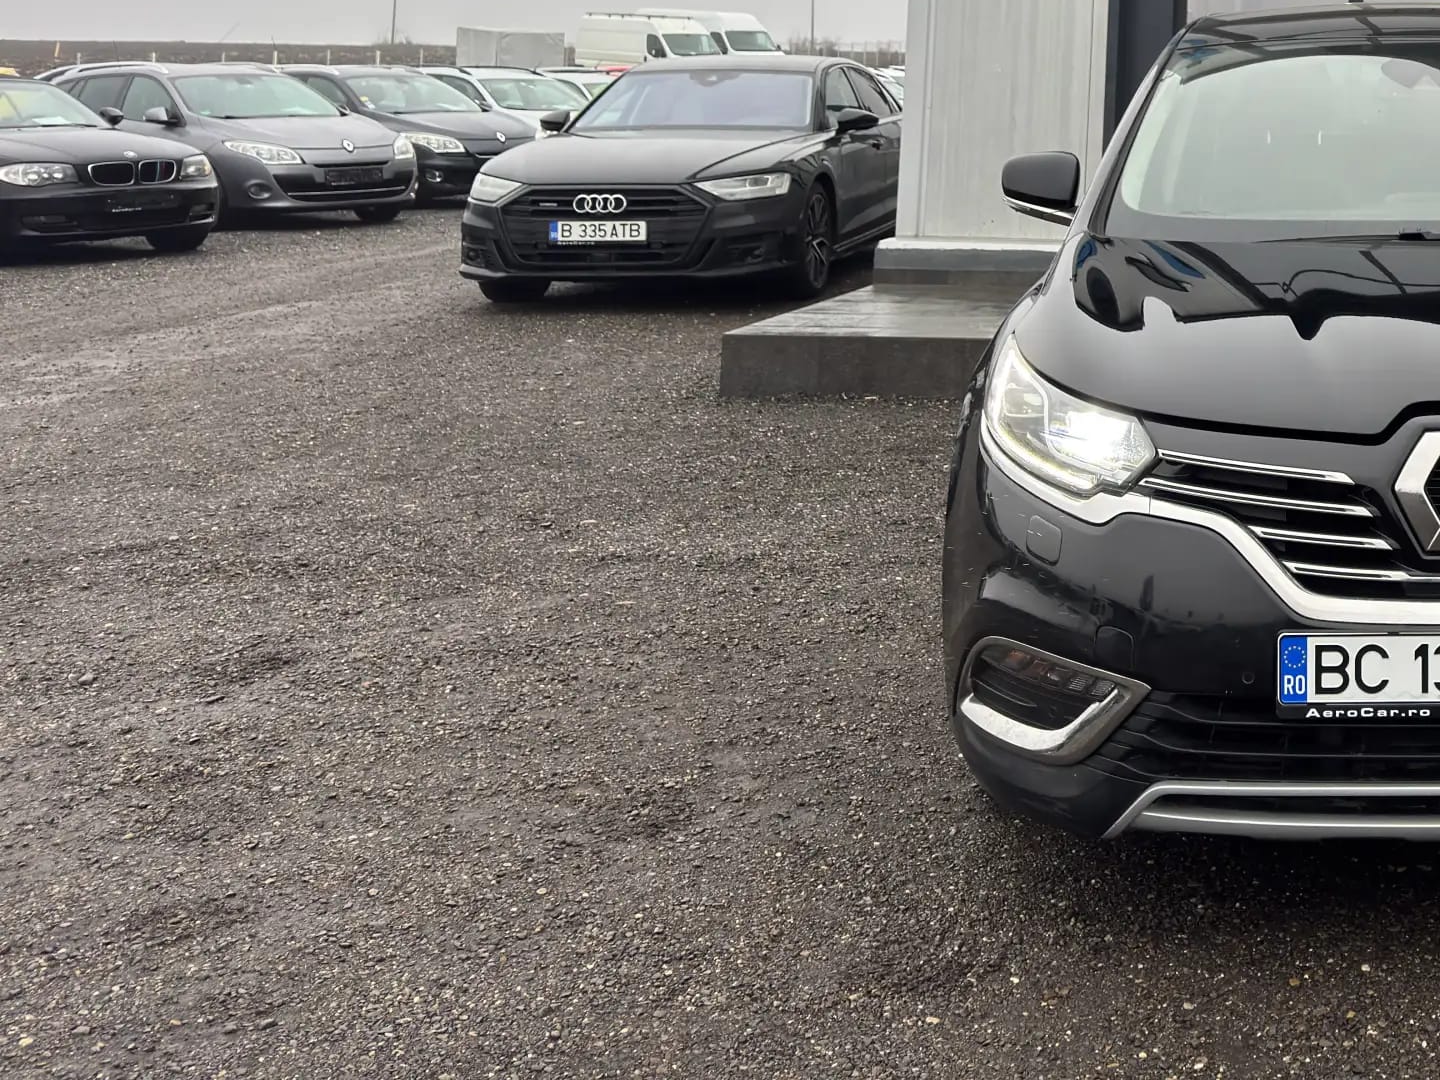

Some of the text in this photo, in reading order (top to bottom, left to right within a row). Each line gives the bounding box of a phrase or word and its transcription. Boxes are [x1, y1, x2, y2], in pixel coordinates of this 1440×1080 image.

[561, 223, 572, 238] B
[579, 223, 607, 238] 335
[610, 223, 641, 238] ATB
[1314, 643, 1390, 695] BC
[1283, 674, 1306, 696] RO
[1305, 706, 1431, 718] AeroCar.ro
